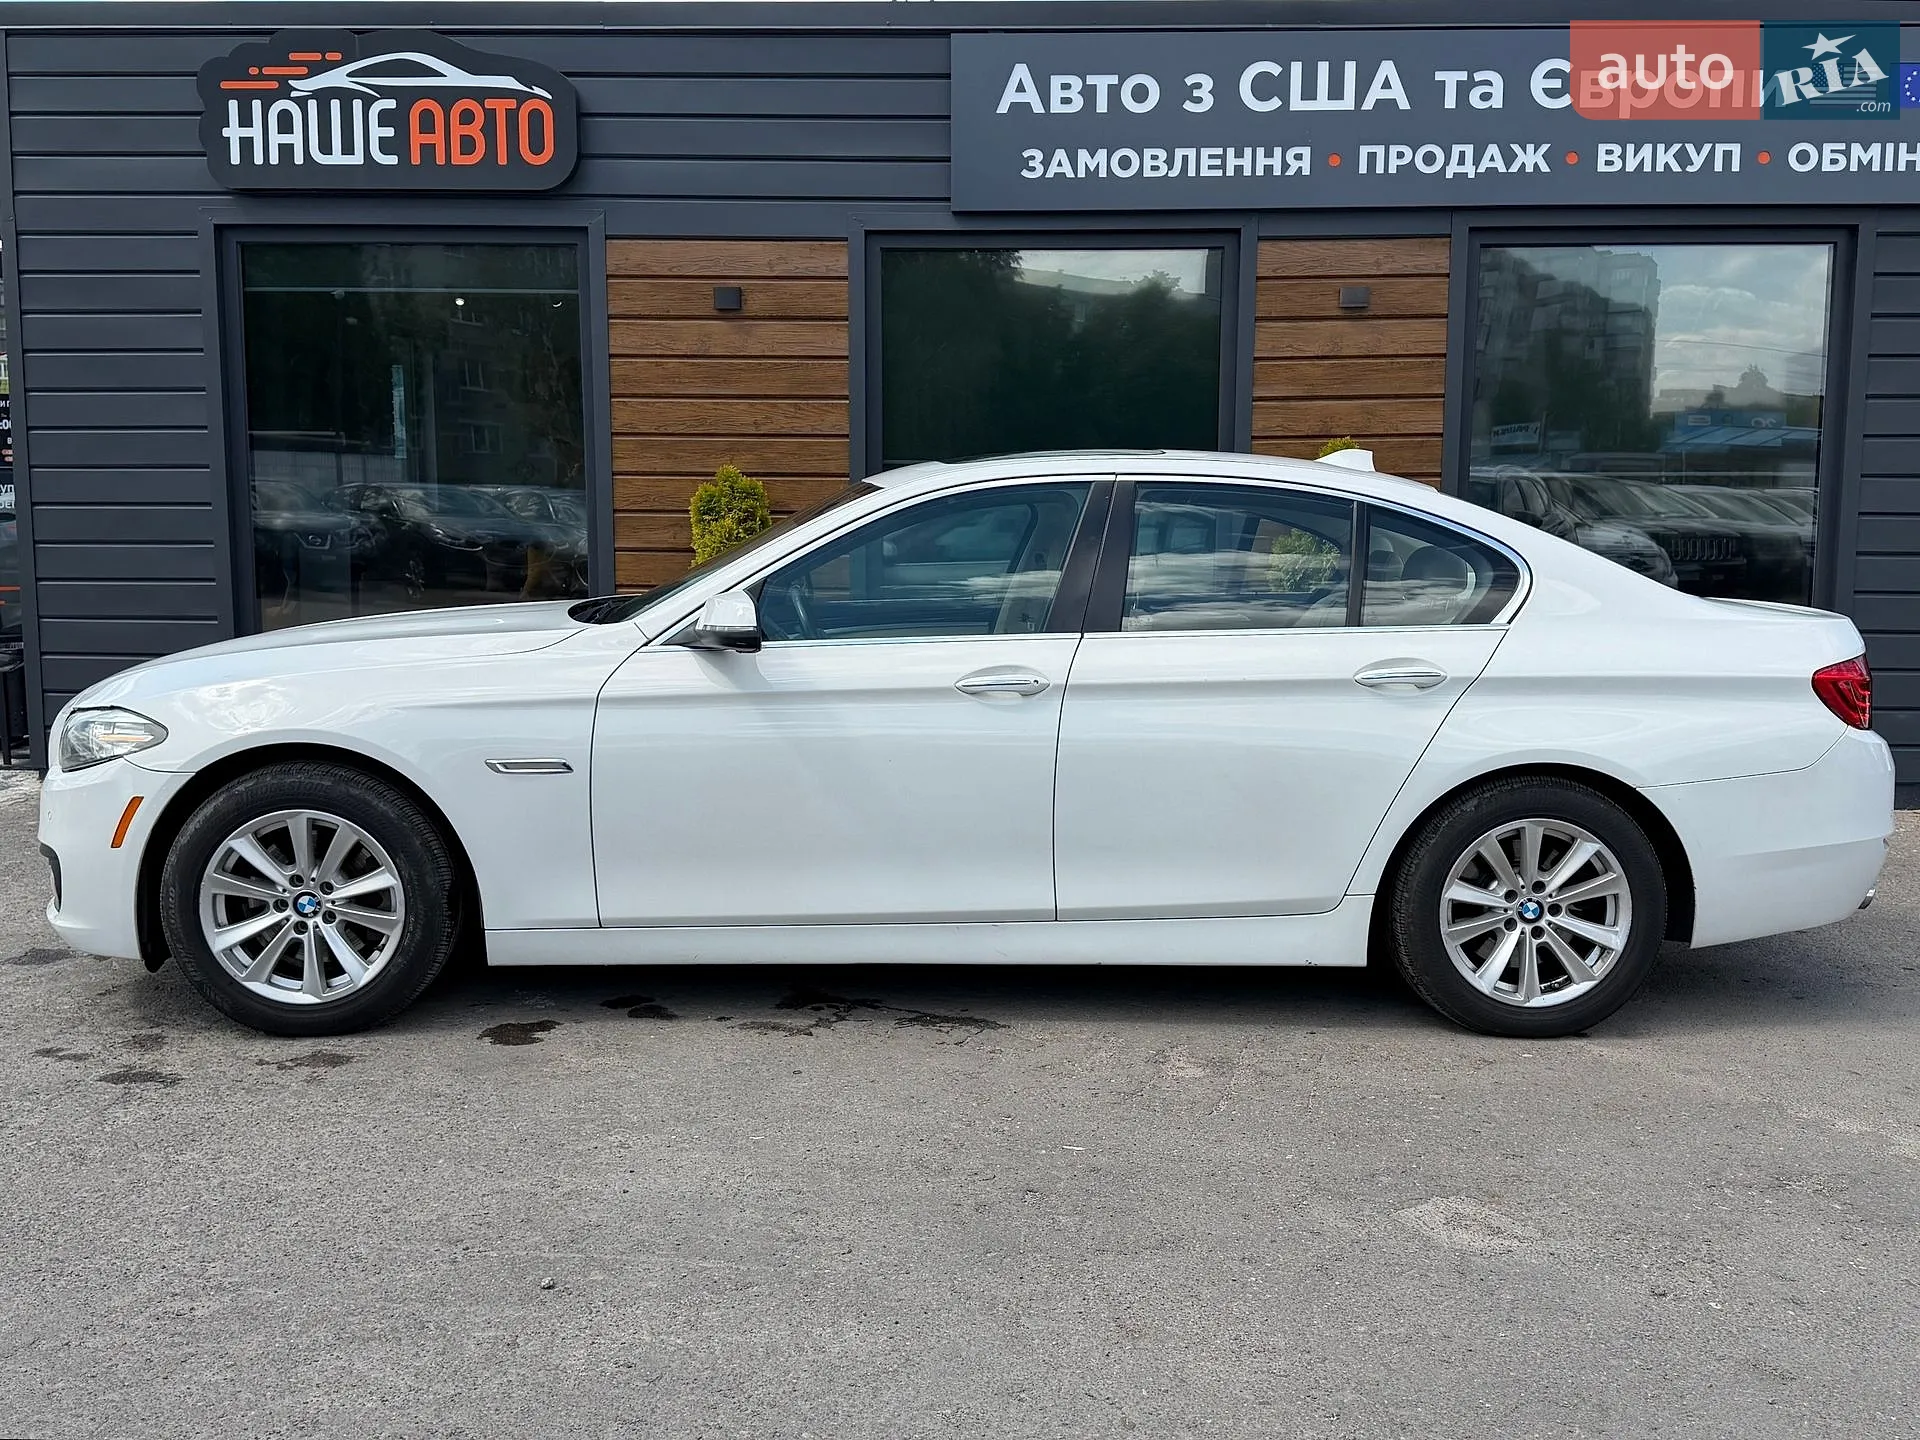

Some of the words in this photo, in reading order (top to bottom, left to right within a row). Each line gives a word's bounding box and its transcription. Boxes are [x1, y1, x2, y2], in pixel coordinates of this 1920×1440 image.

[995, 63, 1160, 114] Авто
[1182, 73, 1215, 113] з
[1238, 60, 1412, 112] США
[1434, 70, 1504, 109] та
[221, 98, 399, 165] НАШЕ
[409, 98, 554, 166] АВТО
[1020, 146, 1311, 178] ЗАМОВЛЕННЯ
[1358, 143, 1552, 179] ПРОДАЖ
[1596, 143, 1741, 173] ВИКУП
[1787, 142, 1920, 173] ОБМІН
